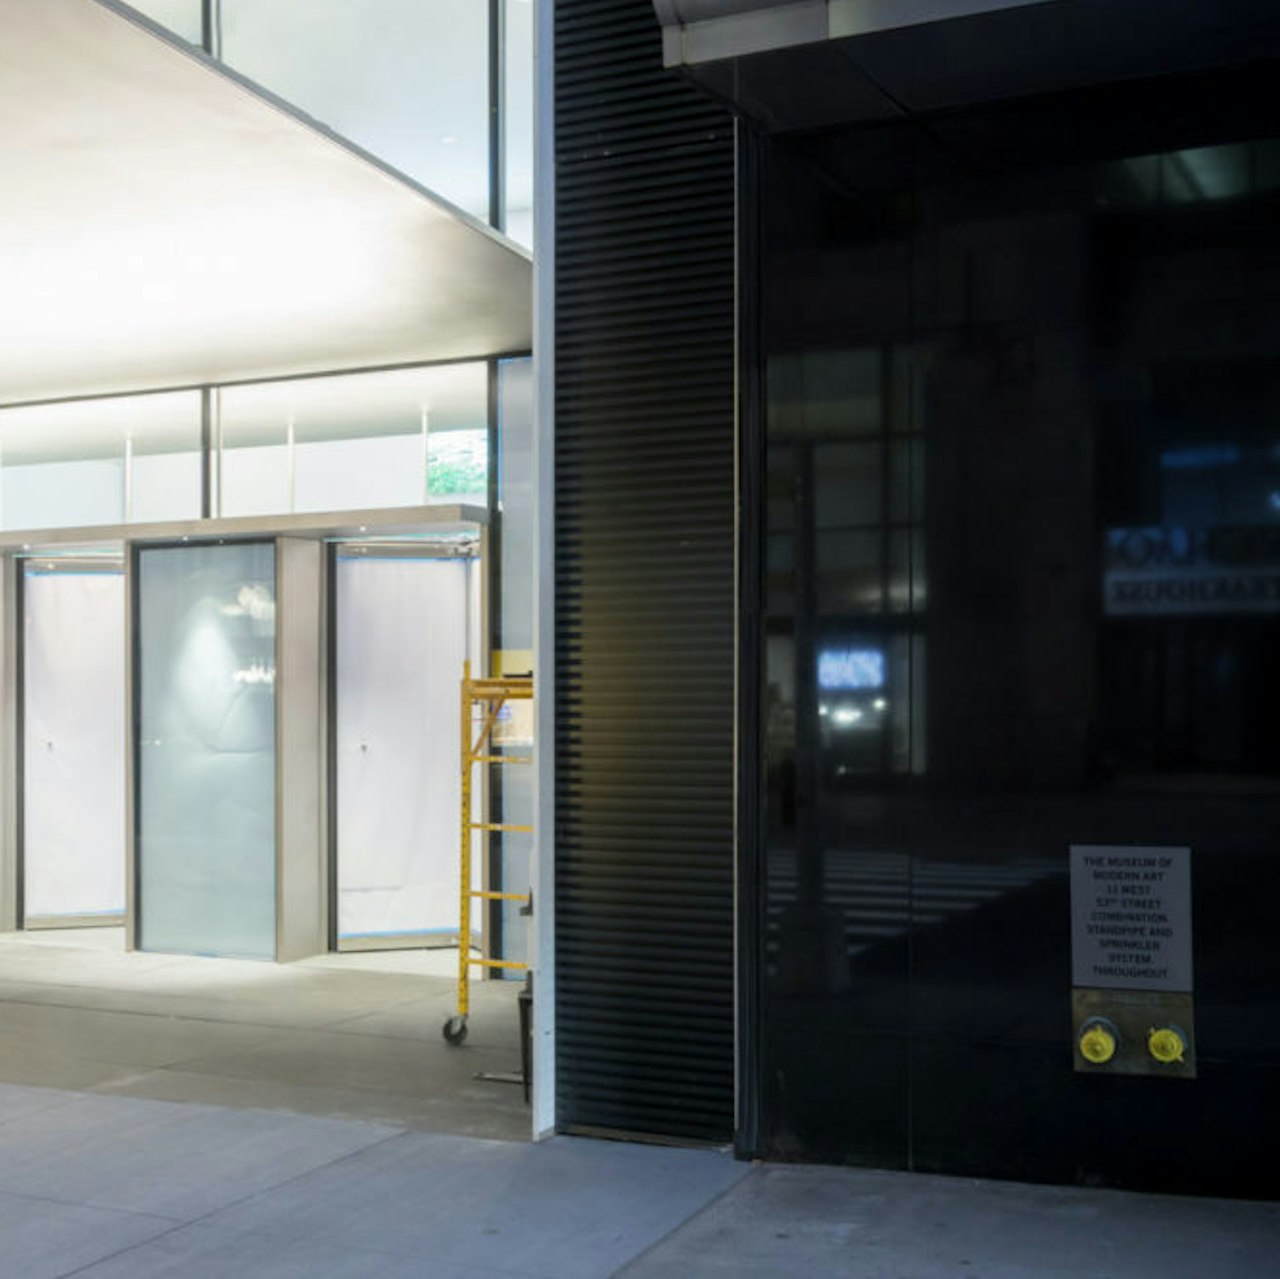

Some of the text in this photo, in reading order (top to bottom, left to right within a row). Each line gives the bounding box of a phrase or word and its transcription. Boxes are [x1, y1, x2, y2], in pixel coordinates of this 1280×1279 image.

[1084, 856, 1172, 868] THE MUSEUM OF
[1093, 870, 1164, 881] MODERN ART
[1122, 885, 1150, 895] WEST
[1122, 898, 1161, 909] STREET
[1090, 911, 1168, 923] COMBINATION
[1086, 924, 1173, 938] STANDPIPE AND
[1099, 939, 1160, 951] SPRINKLER
[1093, 965, 1168, 978] THROUGHOUT
